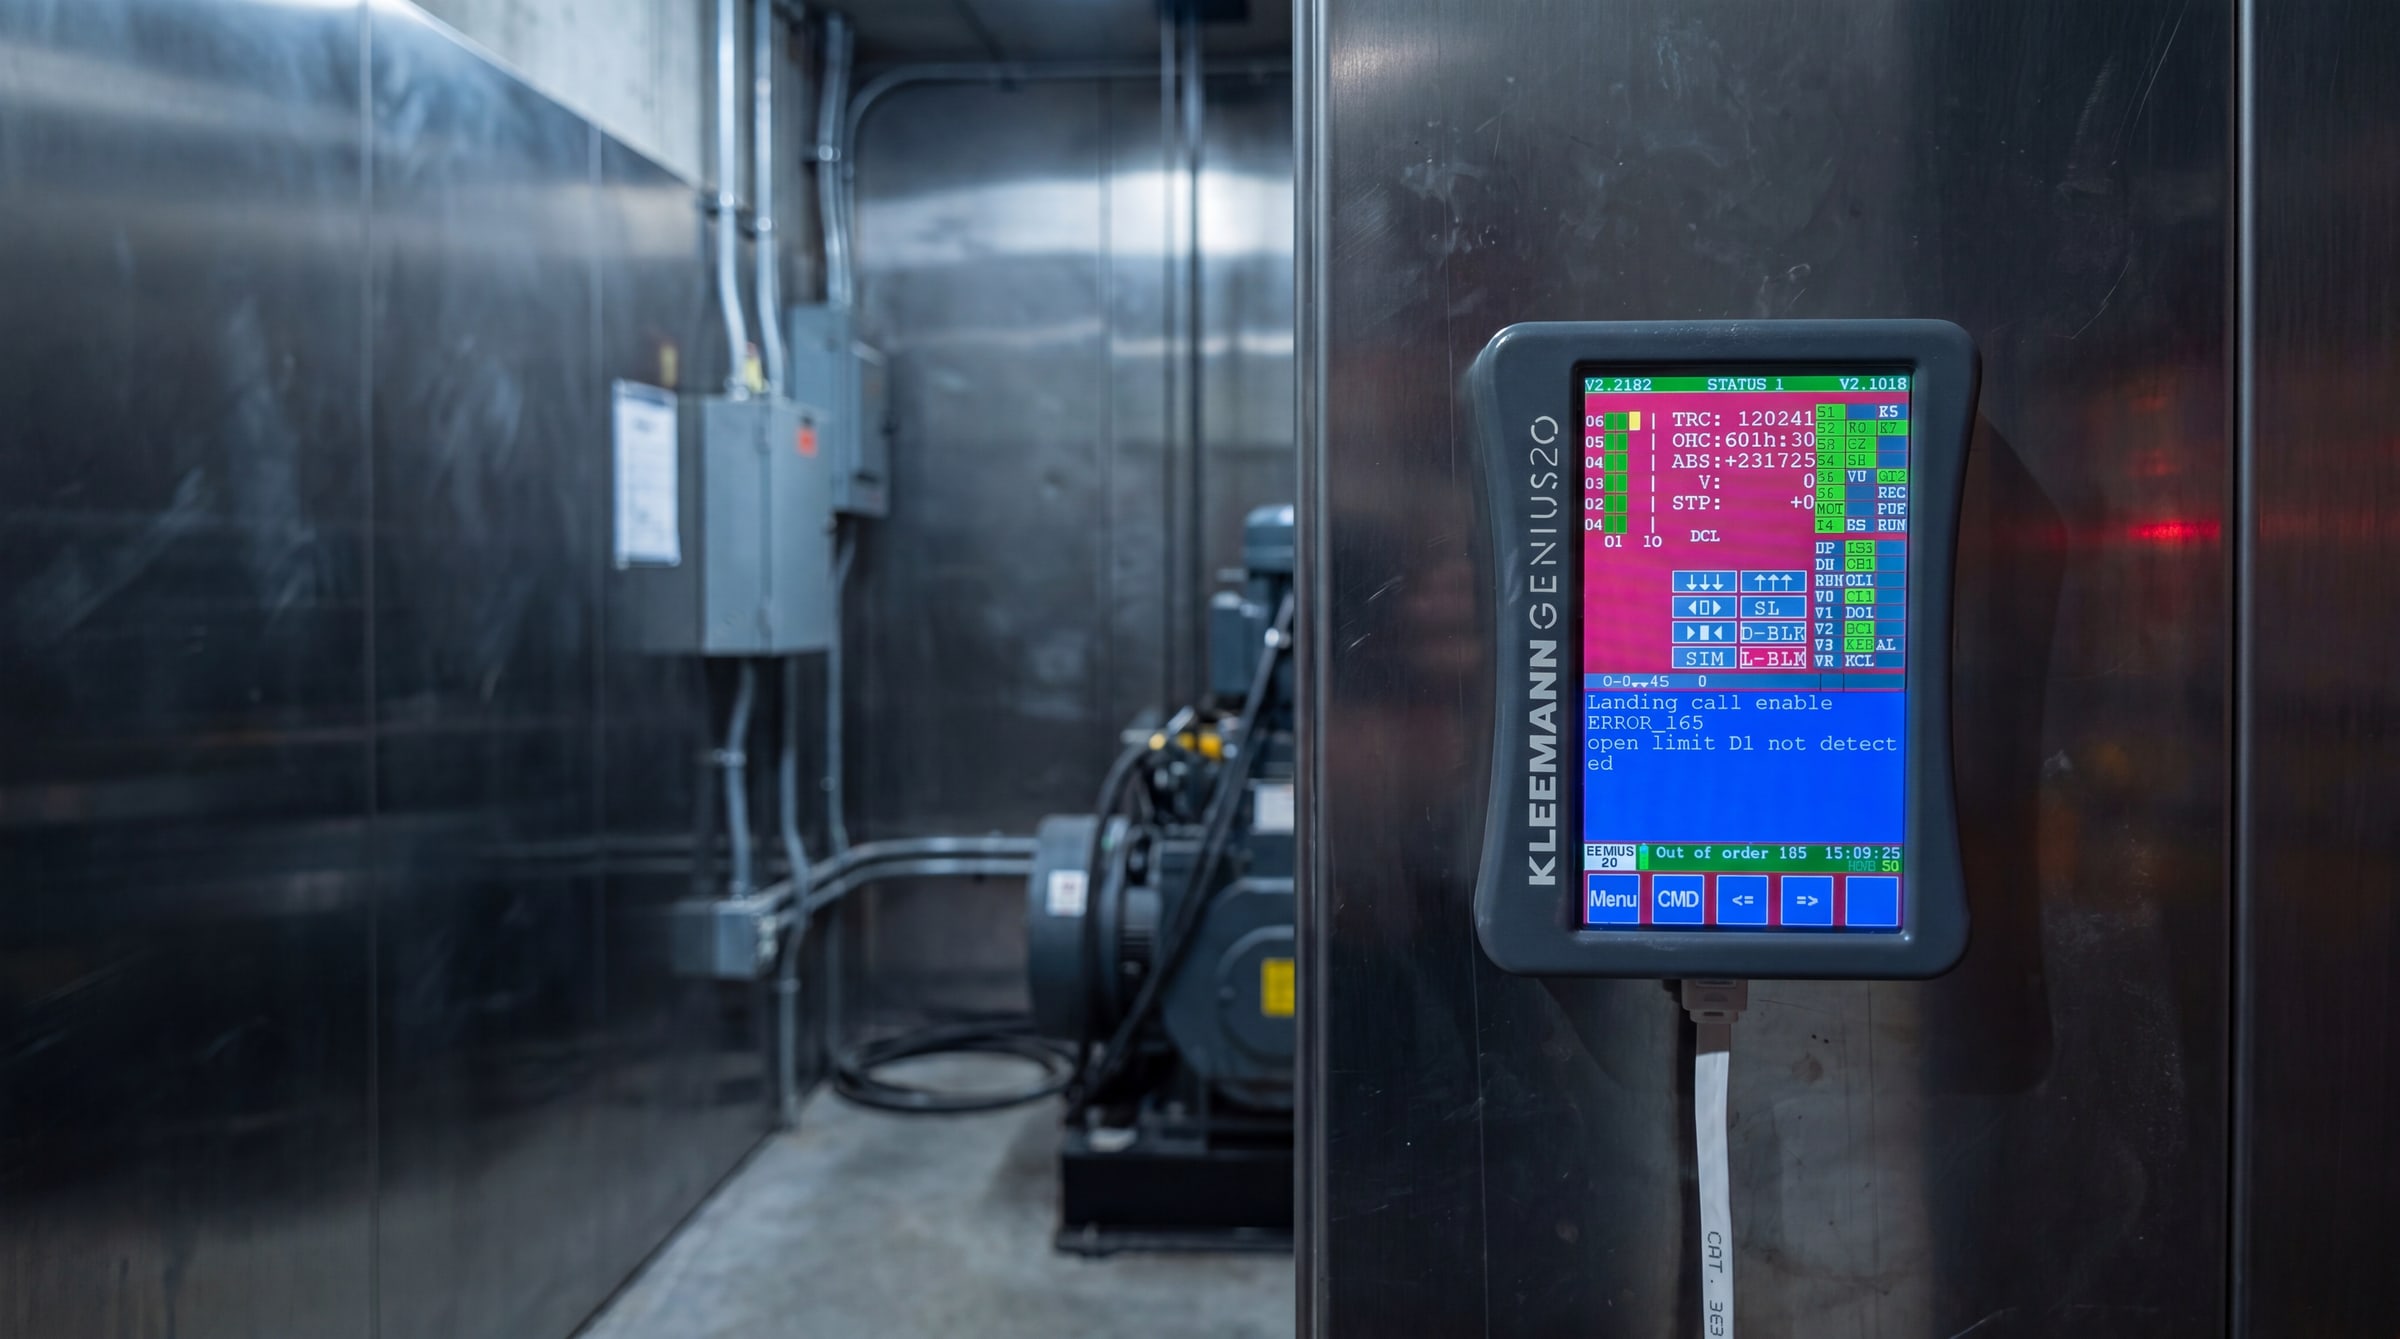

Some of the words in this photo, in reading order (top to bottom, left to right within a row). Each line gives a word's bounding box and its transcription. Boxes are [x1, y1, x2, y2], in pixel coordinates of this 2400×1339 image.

[1585, 379, 1652, 391] V2.2182
[1707, 378, 1767, 391] STATUS
[1775, 378, 1784, 391] 1
[1840, 377, 1907, 390] V2.1018
[1585, 415, 1604, 428] 06
[1672, 411, 1720, 427] TRC:
[1738, 410, 1815, 426] 120241
[1585, 436, 1604, 448] 05
[1585, 456, 1604, 469] 04
[1585, 477, 1604, 490] 03
[1698, 474, 1720, 490] V:
[1803, 473, 1815, 488] 0
[1877, 486, 1906, 499] REC
[1584, 497, 1604, 510] 02
[1672, 495, 1720, 510] STP:
[1790, 494, 1815, 510] +0
[1878, 518, 1907, 531] RUN
[1604, 535, 1622, 548] 01
[1643, 535, 1663, 548] 10
[1690, 530, 1720, 542] DCL
[1754, 600, 1780, 616] SL
[1815, 606, 1834, 619] V1
[1815, 622, 1834, 635] V2
[1815, 638, 1833, 651] V3
[1875, 638, 1897, 651] AL
[1686, 651, 1724, 667] SIM
[1814, 654, 1834, 667] VR
[1845, 654, 1875, 667] KCL
[1587, 693, 1678, 713] Landing
[1691, 694, 1742, 710] call
[1755, 694, 1833, 710] enable
[1587, 715, 1704, 734] ERROR_165
[1587, 737, 1639, 753] open
[1652, 734, 1716, 751] limit
[1768, 736, 1806, 751] not
[1820, 735, 1897, 751] detect
[1528, 639, 1557, 886] KLEEMANN
[1587, 755, 1613, 771] ed
[1586, 845, 1635, 857] EEMIUS
[1656, 846, 1684, 859] Out
[1694, 846, 1712, 859] of
[1722, 846, 1769, 859] order
[1780, 846, 1807, 859] 185
[1825, 846, 1901, 860] 15:09:25
[1601, 858, 1618, 868] 20
[1590, 889, 1637, 908] Menu
[1657, 890, 1700, 908] CMD
